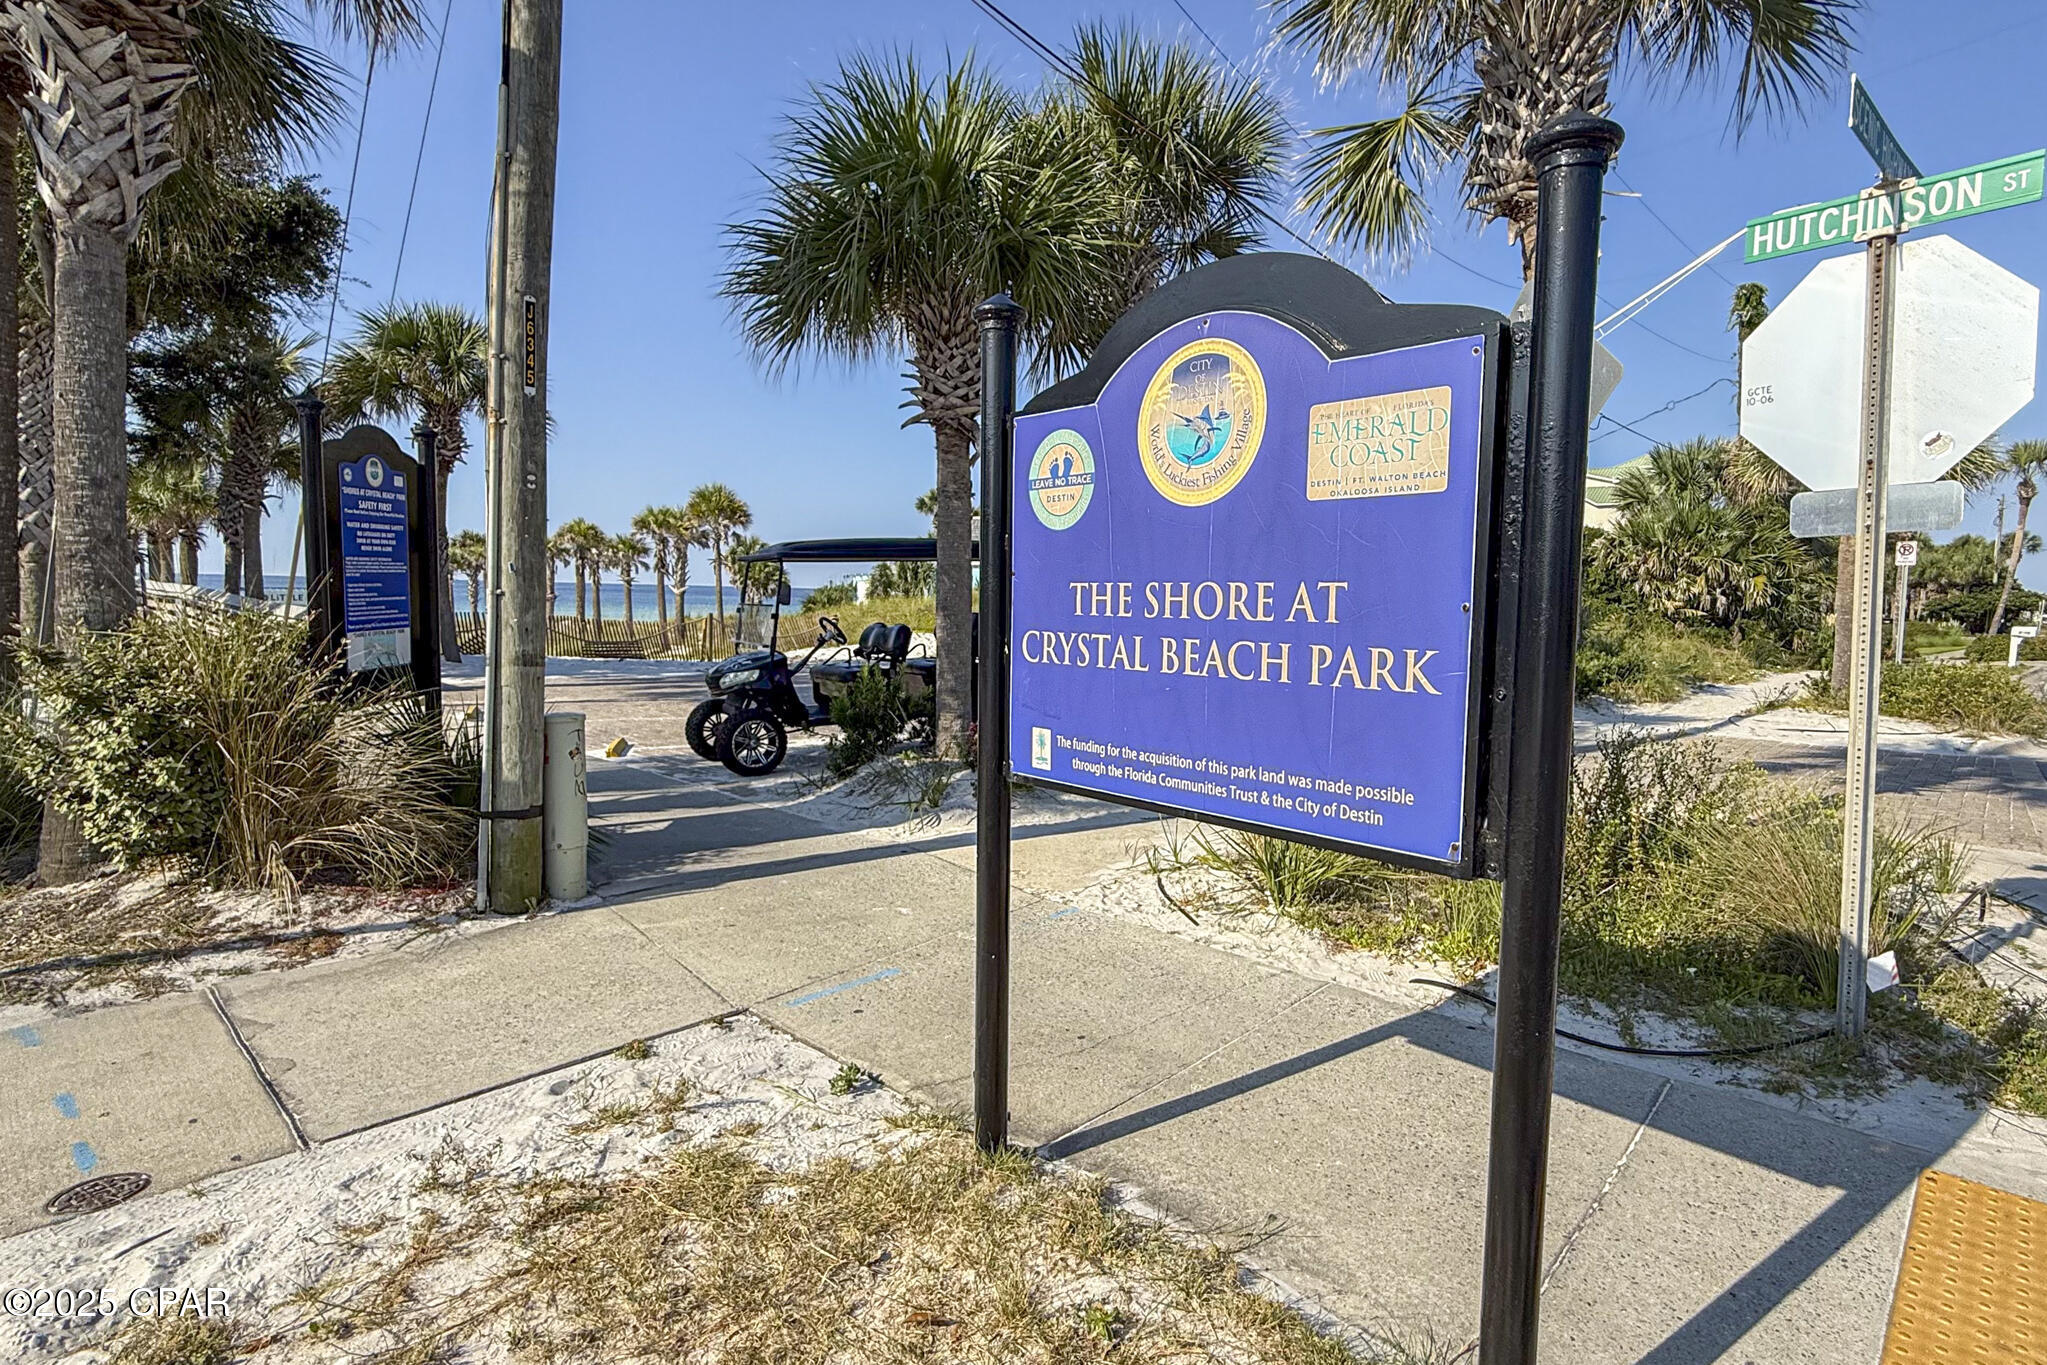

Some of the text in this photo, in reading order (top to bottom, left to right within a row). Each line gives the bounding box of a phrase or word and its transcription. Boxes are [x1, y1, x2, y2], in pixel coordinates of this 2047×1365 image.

[1752, 168, 2031, 256] HUTCHINSON ST
[526, 304, 535, 385] J6345
[1189, 357, 1213, 373] CITY
[1746, 395, 1774, 406] 10-06
[1747, 385, 1773, 397] GCTE
[1312, 407, 1449, 445] EMERALD
[1150, 408, 1253, 488] World's Luckiest Fishing Village
[1329, 438, 1422, 468] COAST
[1031, 474, 1092, 489] LEAVE NO TRACE
[1310, 477, 1341, 488] DESTIN
[1369, 472, 1409, 483] WALTON
[1413, 470, 1446, 480] BEACH
[1329, 484, 1420, 497] OKALOOSA ISLAND
[1046, 493, 1075, 503] DESTIN
[1069, 581, 1348, 624] THE SHORE AT
[1022, 630, 1443, 695] CRYSTAL BEACH PARK
[1056, 735, 1415, 806] The funding for the acquisition of this park land was made possible
[1072, 757, 1384, 826] through the Florida Communities Trust & the City of Destin
